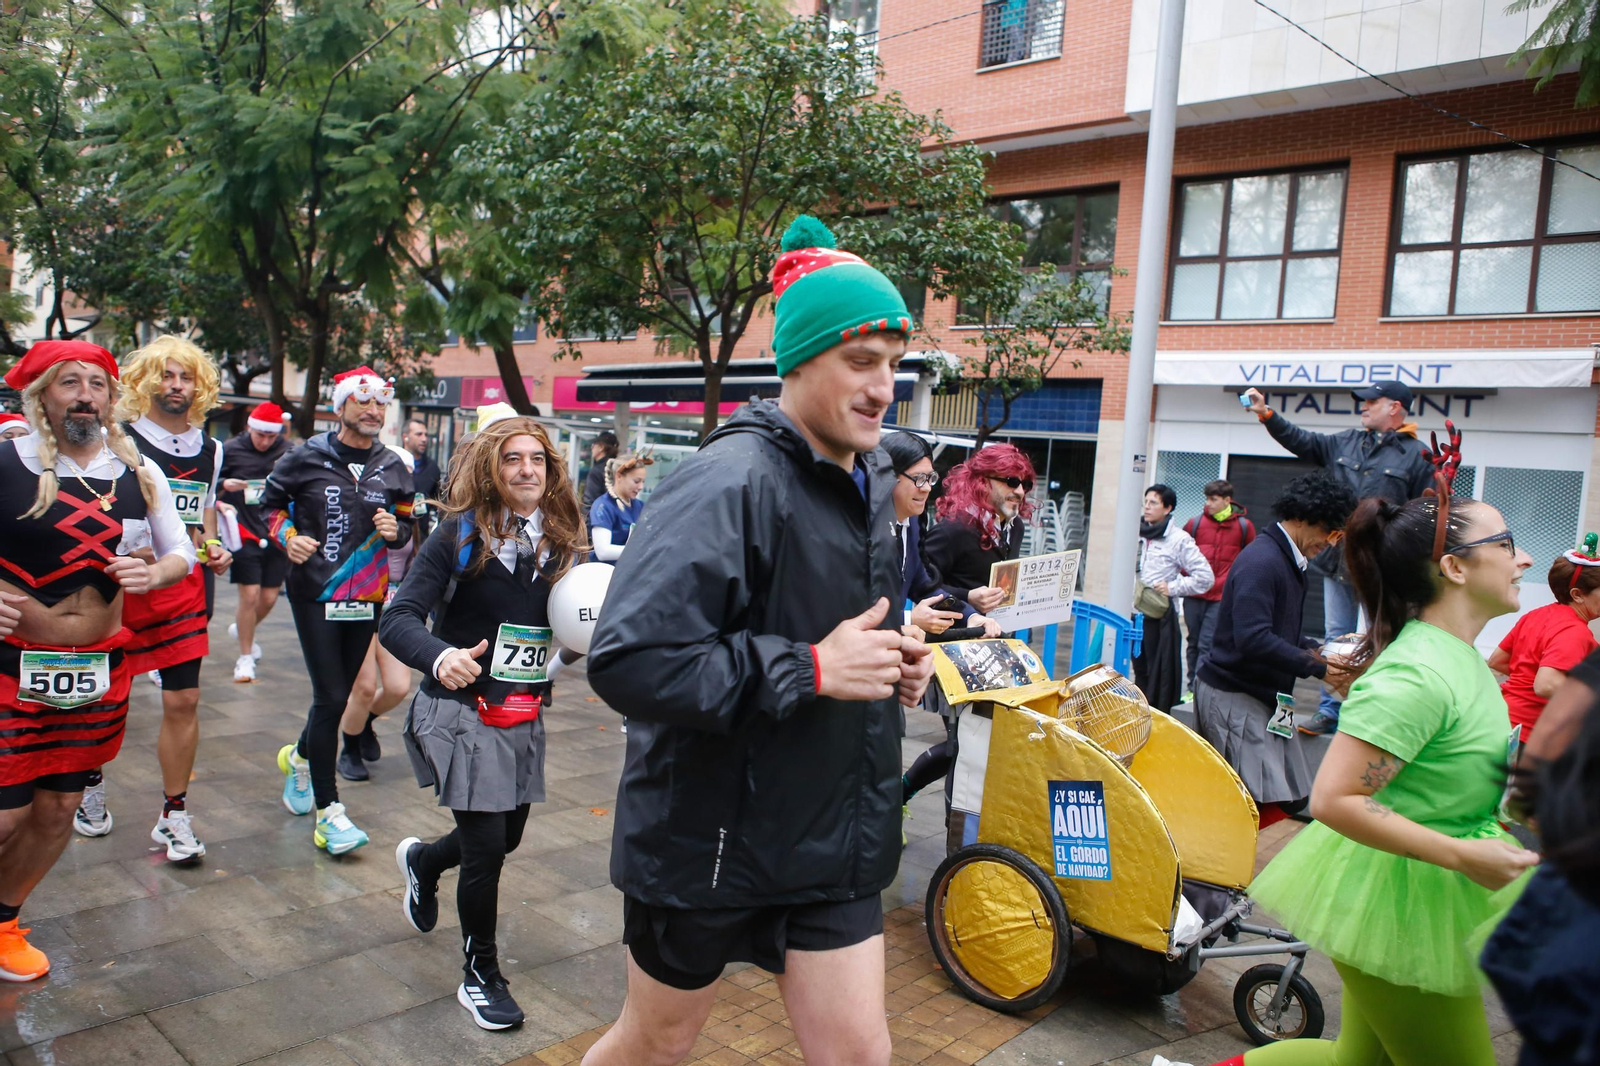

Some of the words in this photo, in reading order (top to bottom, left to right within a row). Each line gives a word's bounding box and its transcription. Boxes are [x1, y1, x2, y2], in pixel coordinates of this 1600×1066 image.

[1238, 363, 1453, 384] VITALDENT
[1236, 392, 1484, 417] ITALNT
[175, 494, 200, 512] 04
[323, 485, 343, 562] CORRUCO
[1023, 559, 1061, 573] 19712
[1039, 572, 1059, 580] NACIONAL
[578, 607, 598, 621] EL
[502, 643, 548, 667] 730
[29, 671, 97, 694] 505
[1054, 789, 1065, 803] ¿Y
[1067, 790, 1077, 803] SI
[1078, 790, 1096, 804] CAE
[1054, 799, 1106, 838] AQUÍ
[1055, 845, 1068, 862] EL
[1070, 846, 1108, 865] GORDO
[1056, 863, 1067, 875] DE
[1068, 864, 1109, 879] NAVIDAD?
